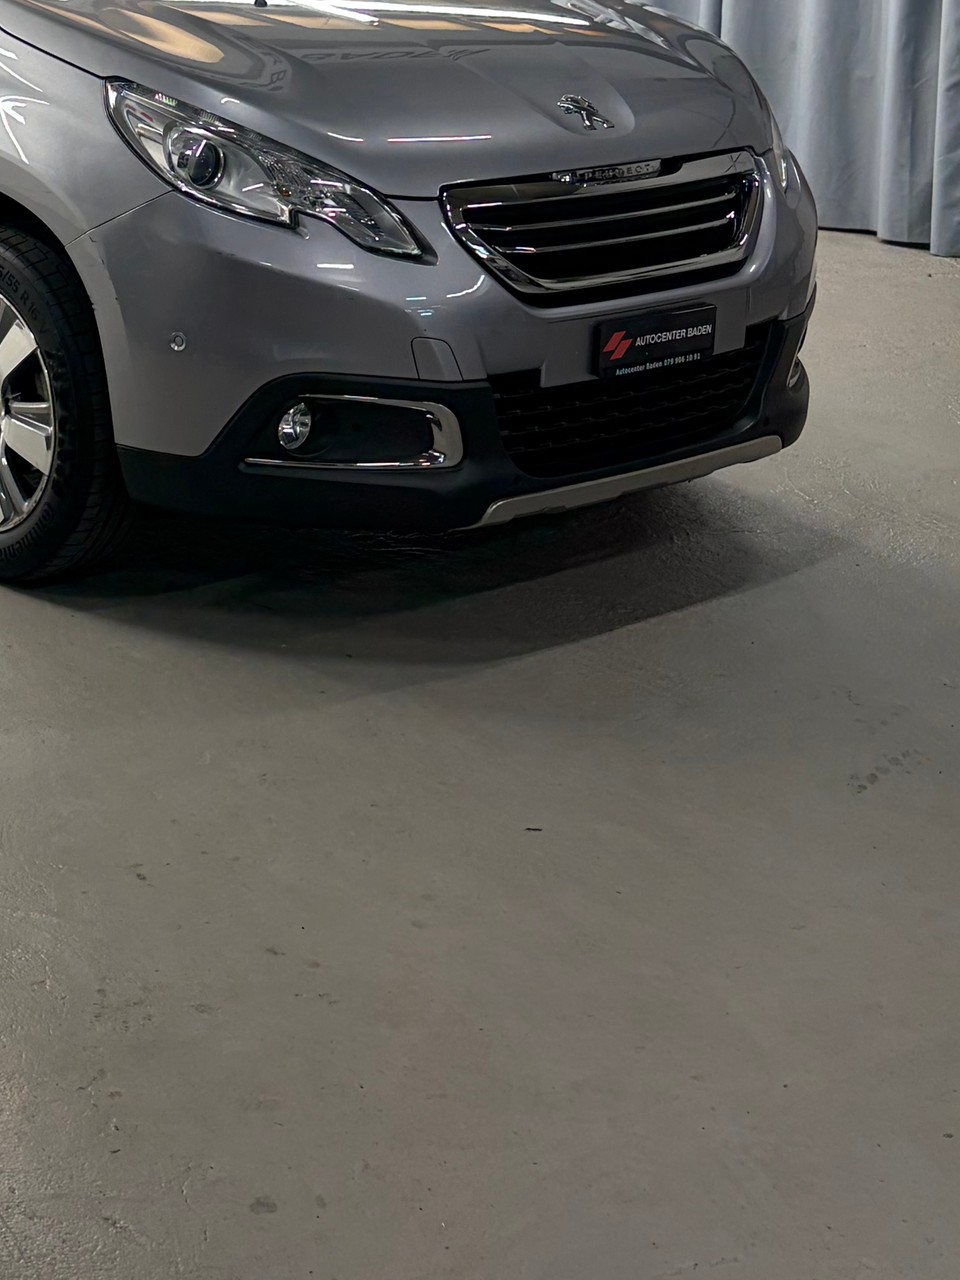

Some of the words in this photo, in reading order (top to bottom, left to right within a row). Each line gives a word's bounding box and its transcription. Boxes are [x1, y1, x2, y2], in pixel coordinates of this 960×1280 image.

[20, 290, 30, 305] R
[635, 329, 687, 347] AUTOCENTER
[687, 324, 713, 338] BADEN
[615, 365, 645, 376] Autocenter
[646, 361, 663, 370] Baden
[664, 357, 674, 366] 079
[686, 353, 693, 362] 10
